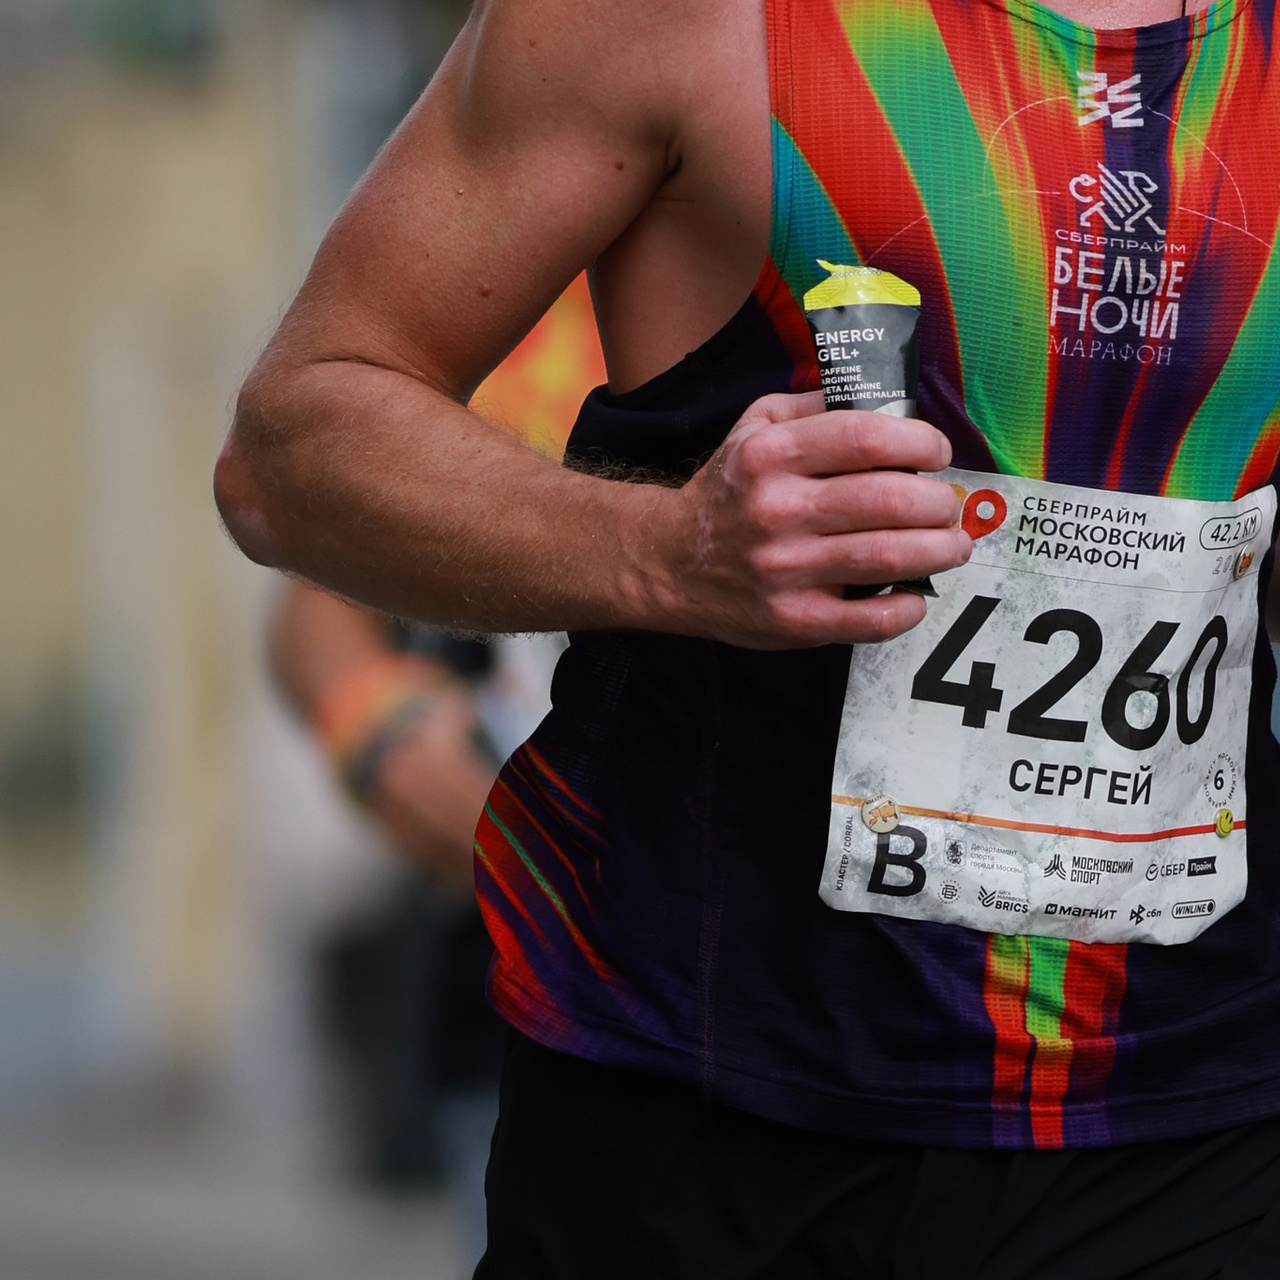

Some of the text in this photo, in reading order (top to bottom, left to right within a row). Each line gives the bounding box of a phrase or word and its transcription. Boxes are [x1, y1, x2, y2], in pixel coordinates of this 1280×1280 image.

[1055, 229, 1186, 254] СБЕРПРАЙМ
[1054, 245, 1185, 298] БЕЛЫЕ
[1050, 288, 1180, 340] НОЧИ
[815, 328, 885, 346] ENERGY
[818, 347, 860, 362] GEL+
[1048, 335, 1173, 365] МАРАФОН
[820, 365, 862, 376] CAFFEINE
[843, 382, 882, 392] ALANINE
[873, 390, 906, 399] MALATE
[1023, 496, 1148, 526] СБЕРПРАЙМ
[1018, 515, 1186, 553] МОСКОВСКИЙ
[1210, 522, 1241, 543] 42,2
[1015, 536, 1140, 570] МАРАФОН
[910, 594, 1228, 752] 4260
[1008, 758, 1153, 805] СЕРГЕЙ
[1214, 769, 1224, 790] 6
[835, 854, 849, 891] КЛАСТЕР
[845, 815, 854, 847] CORRAL
[971, 843, 1018, 856] Департамент
[971, 853, 995, 861] спорта
[1071, 856, 1134, 874] МОСКОВСКИЙ
[1160, 861, 1212, 877] СБЕР Прайм
[1070, 870, 1102, 885] СПОРТ
[995, 900, 1028, 913] BRICS
[1146, 908, 1162, 918] сбп
[1175, 903, 1207, 916] WINLINE
